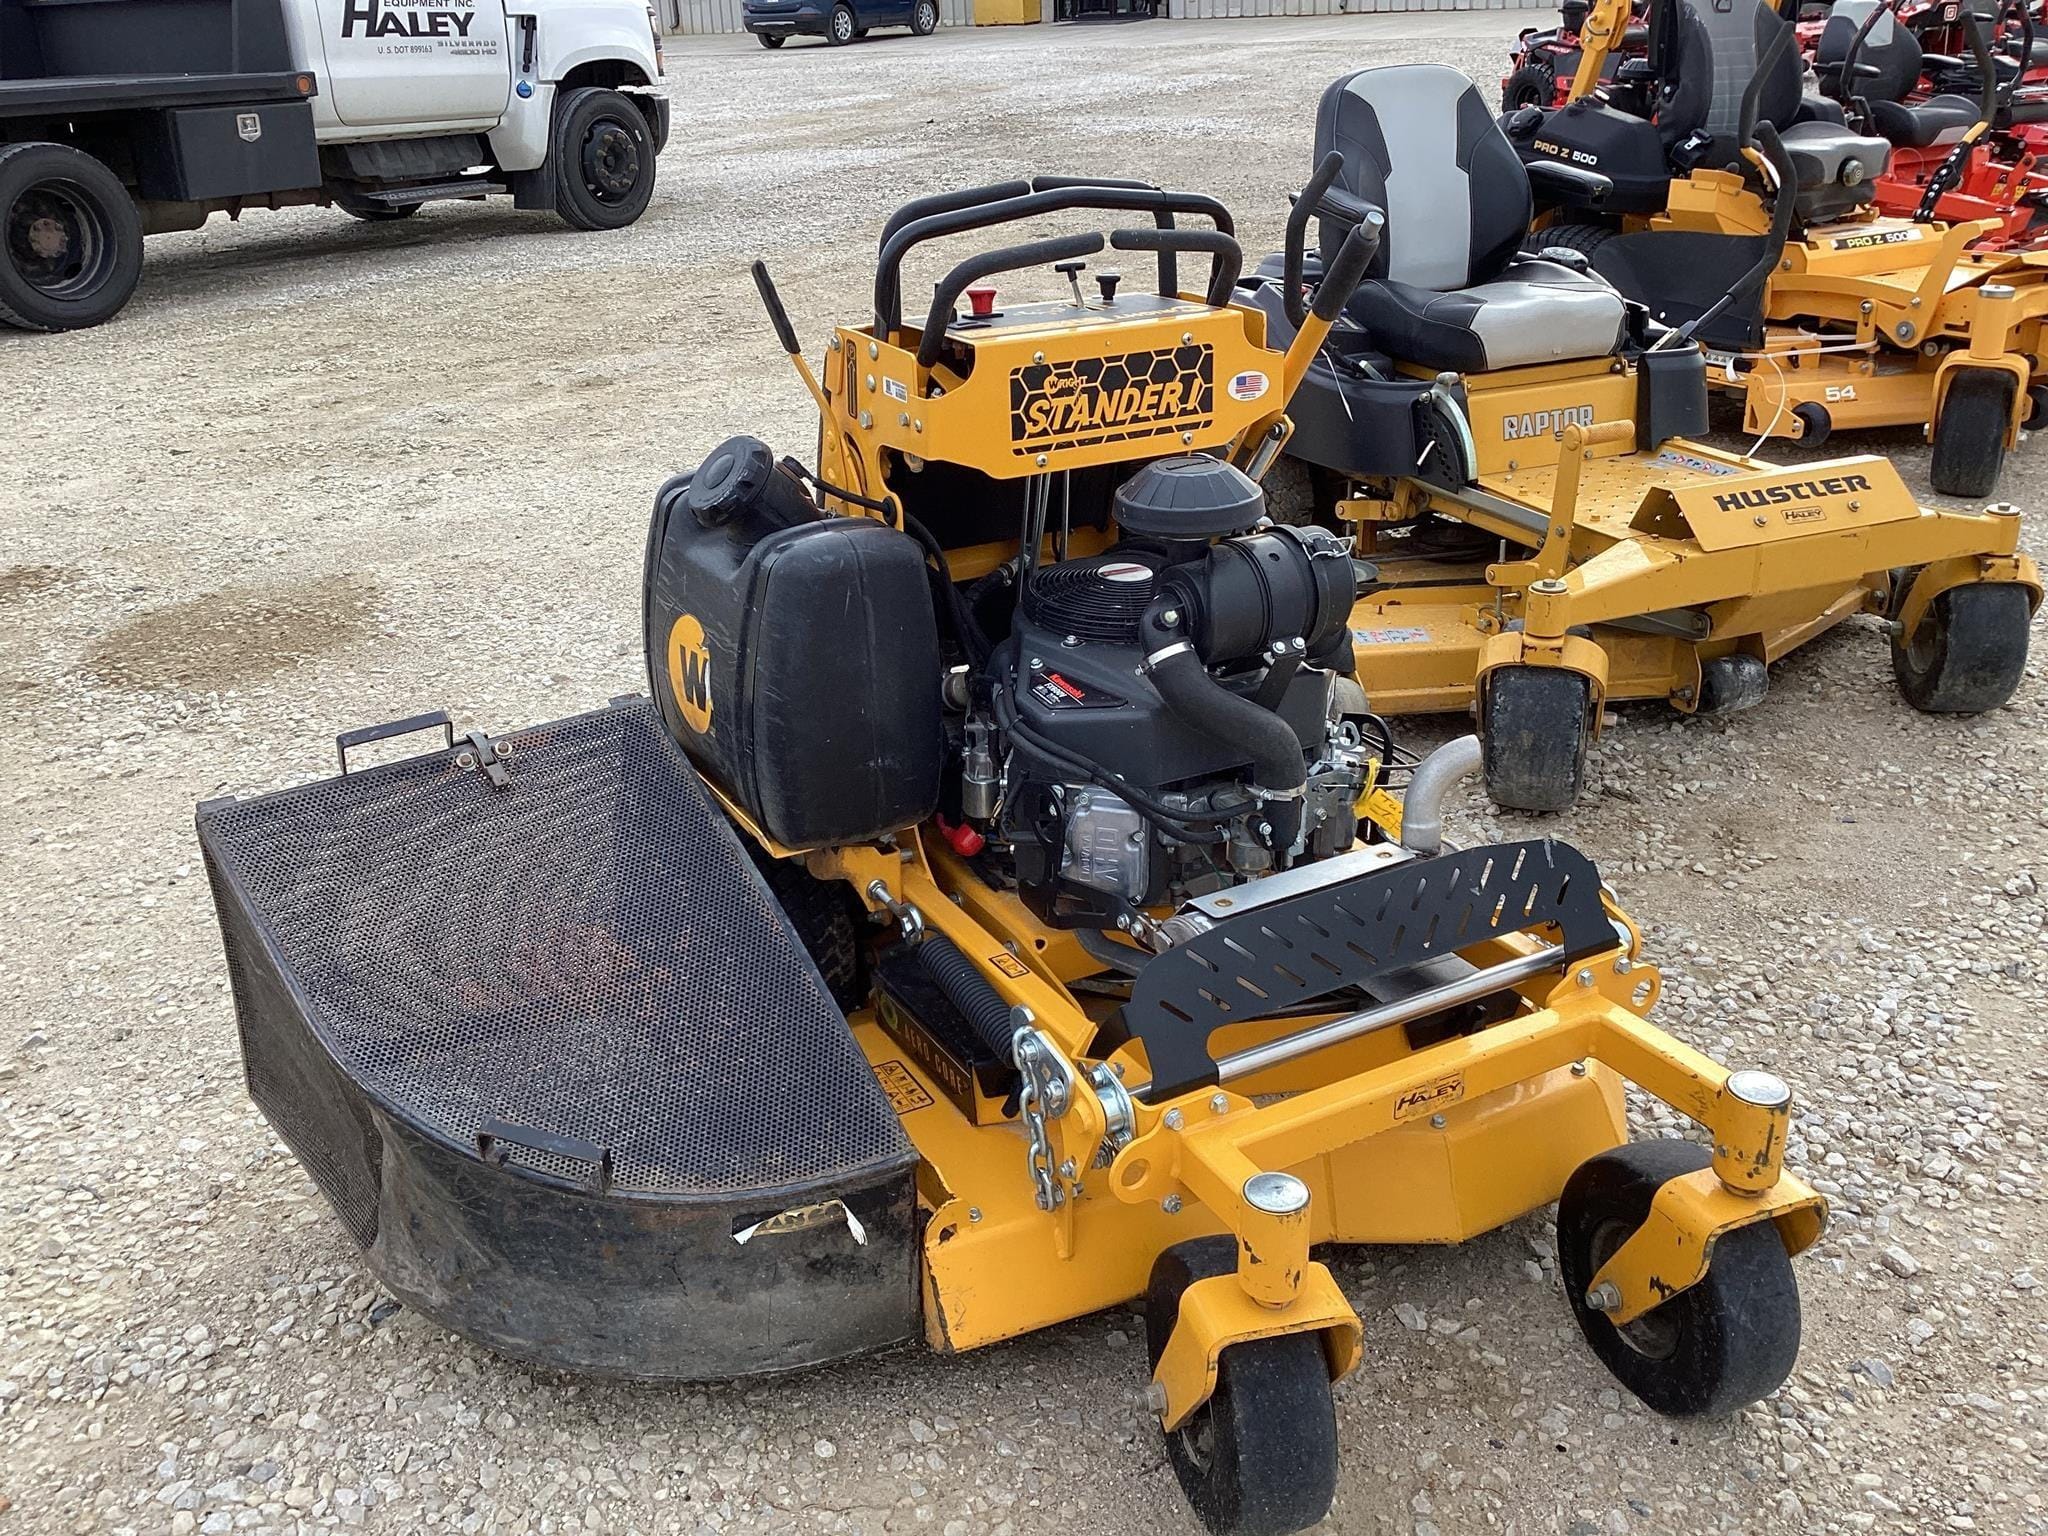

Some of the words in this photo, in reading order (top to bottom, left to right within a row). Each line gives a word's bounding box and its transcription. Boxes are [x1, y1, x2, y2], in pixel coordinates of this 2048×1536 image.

[455, 0, 476, 8] INC.
[341, 0, 475, 38] HALEY
[394, 46, 409, 54] DOT
[410, 45, 433, 54] 899163
[1533, 139, 1559, 155] PRO
[1560, 147, 1570, 158] Z
[1572, 150, 1598, 166] 500
[1846, 236, 1873, 248] PRO
[1873, 235, 1884, 244] Z
[1885, 231, 1909, 243] 500
[1044, 375, 1088, 395] WRIGHT
[1825, 384, 1857, 401] 54
[1025, 381, 1183, 433] STANDER
[1503, 404, 1594, 441] RAPTOR
[1712, 474, 1872, 512] HUSTLER
[1049, 673, 1086, 699] Kawasaki
[1396, 1081, 1461, 1112] HALEY
